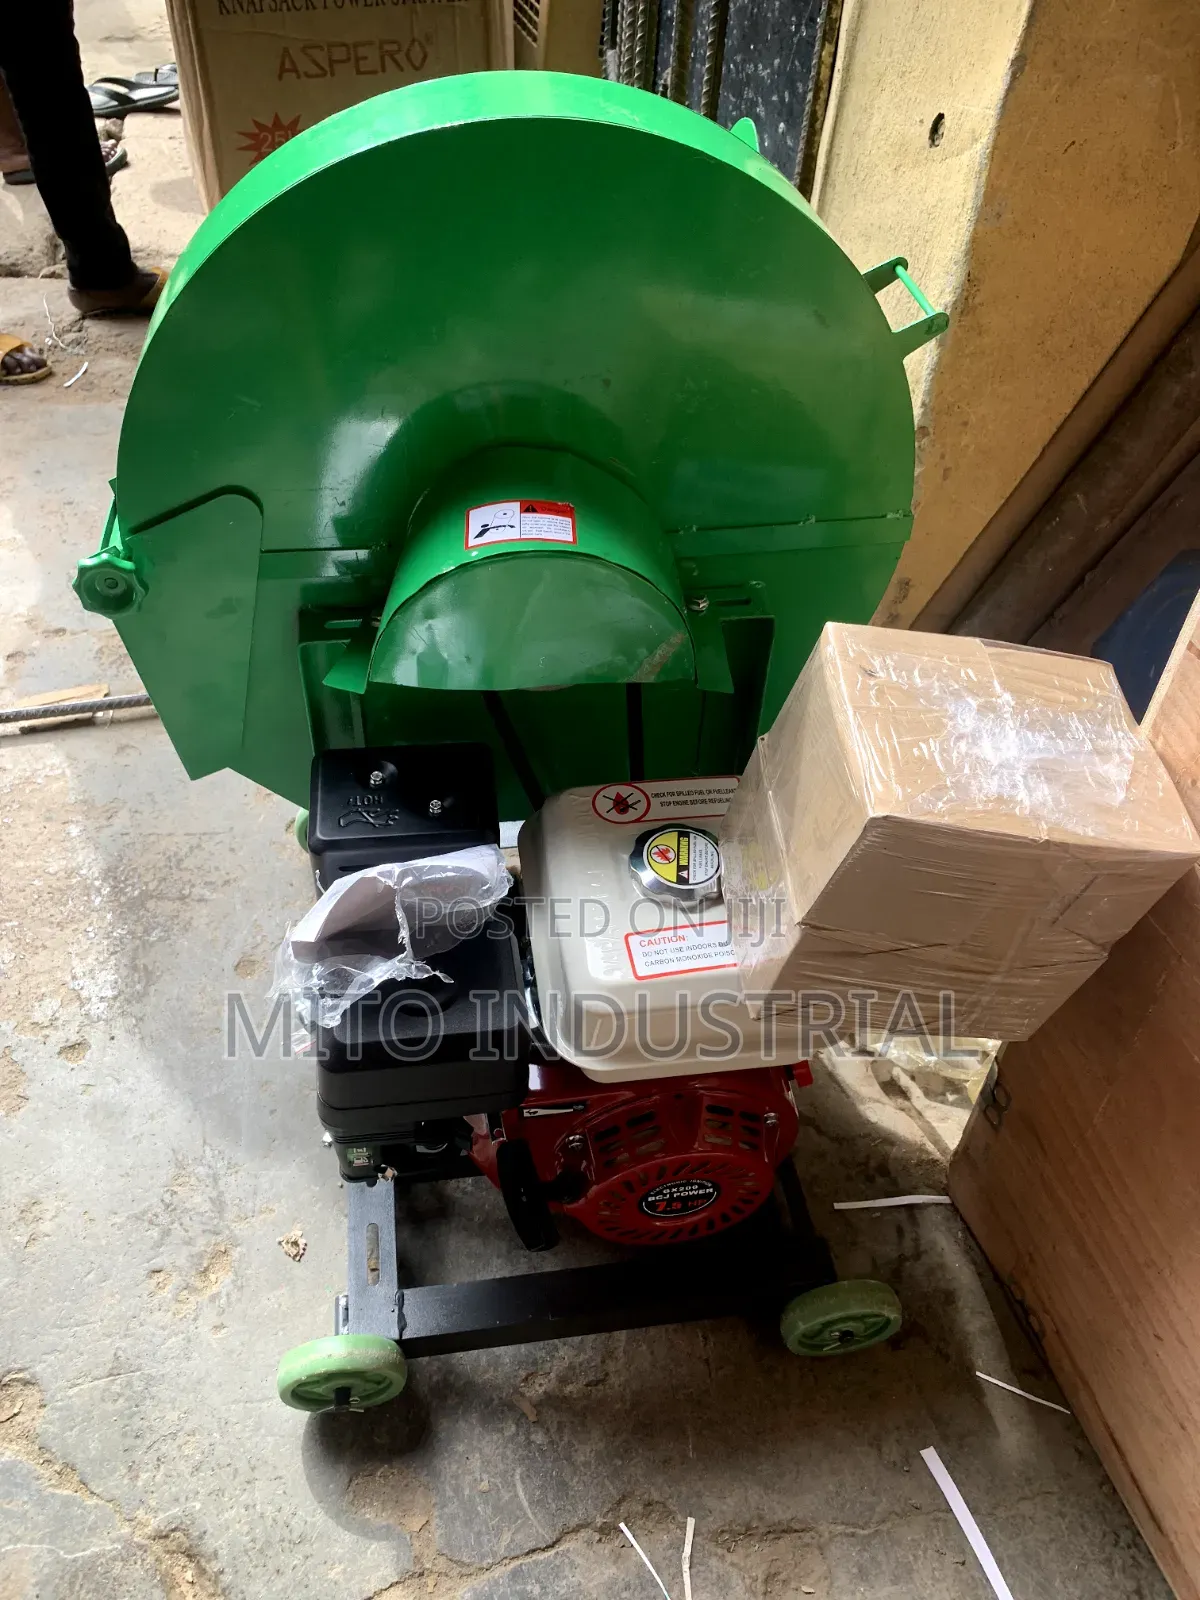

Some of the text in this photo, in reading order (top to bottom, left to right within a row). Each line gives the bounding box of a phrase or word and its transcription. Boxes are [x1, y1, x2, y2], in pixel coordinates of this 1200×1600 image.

[277, 36, 428, 81] ASPERO
[679, 837, 689, 866] WARNING
[686, 942, 717, 951] INDOORS
[644, 958, 675, 967] CARBON
[676, 952, 713, 962] MONOXIDE
[673, 1188, 713, 1197] POWER
